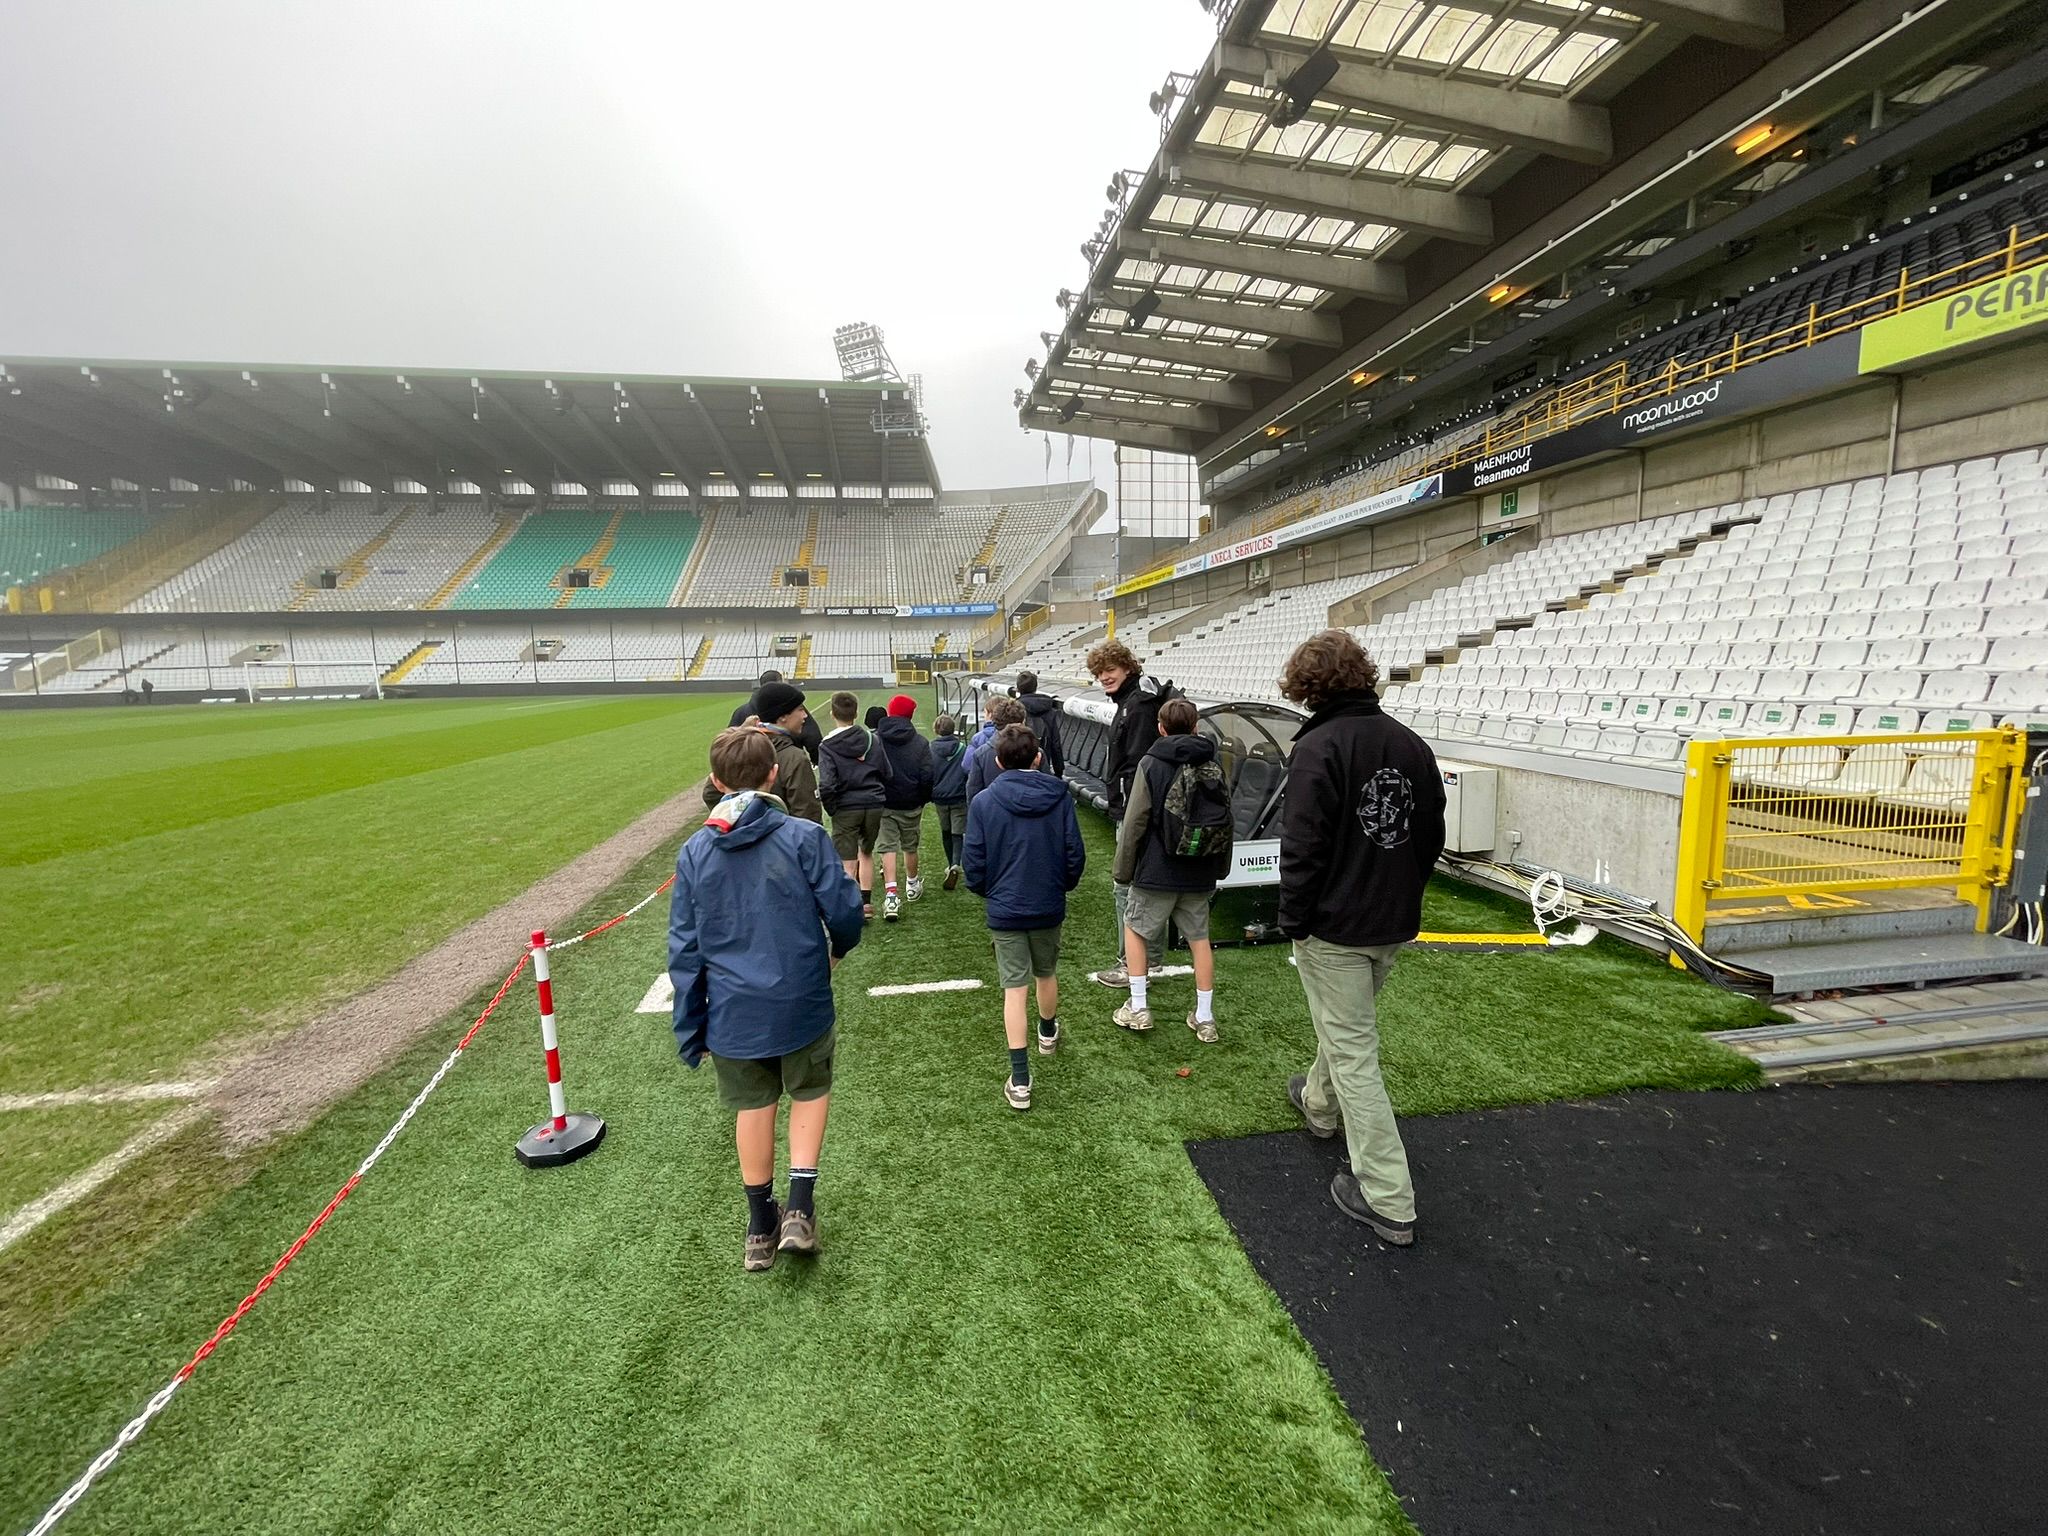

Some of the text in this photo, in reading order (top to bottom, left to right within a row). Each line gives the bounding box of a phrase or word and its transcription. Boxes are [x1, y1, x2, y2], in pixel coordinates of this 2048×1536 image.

[1623, 380, 1720, 430] moonwood
[1636, 424, 1656, 434] making
[1673, 414, 1686, 422] with
[1474, 444, 1533, 474] MAENHOUT
[1474, 459, 1531, 487] Cleanmood
[1210, 536, 1273, 565] ANECA SERVICES
[1240, 855, 1279, 867] UNIBET
